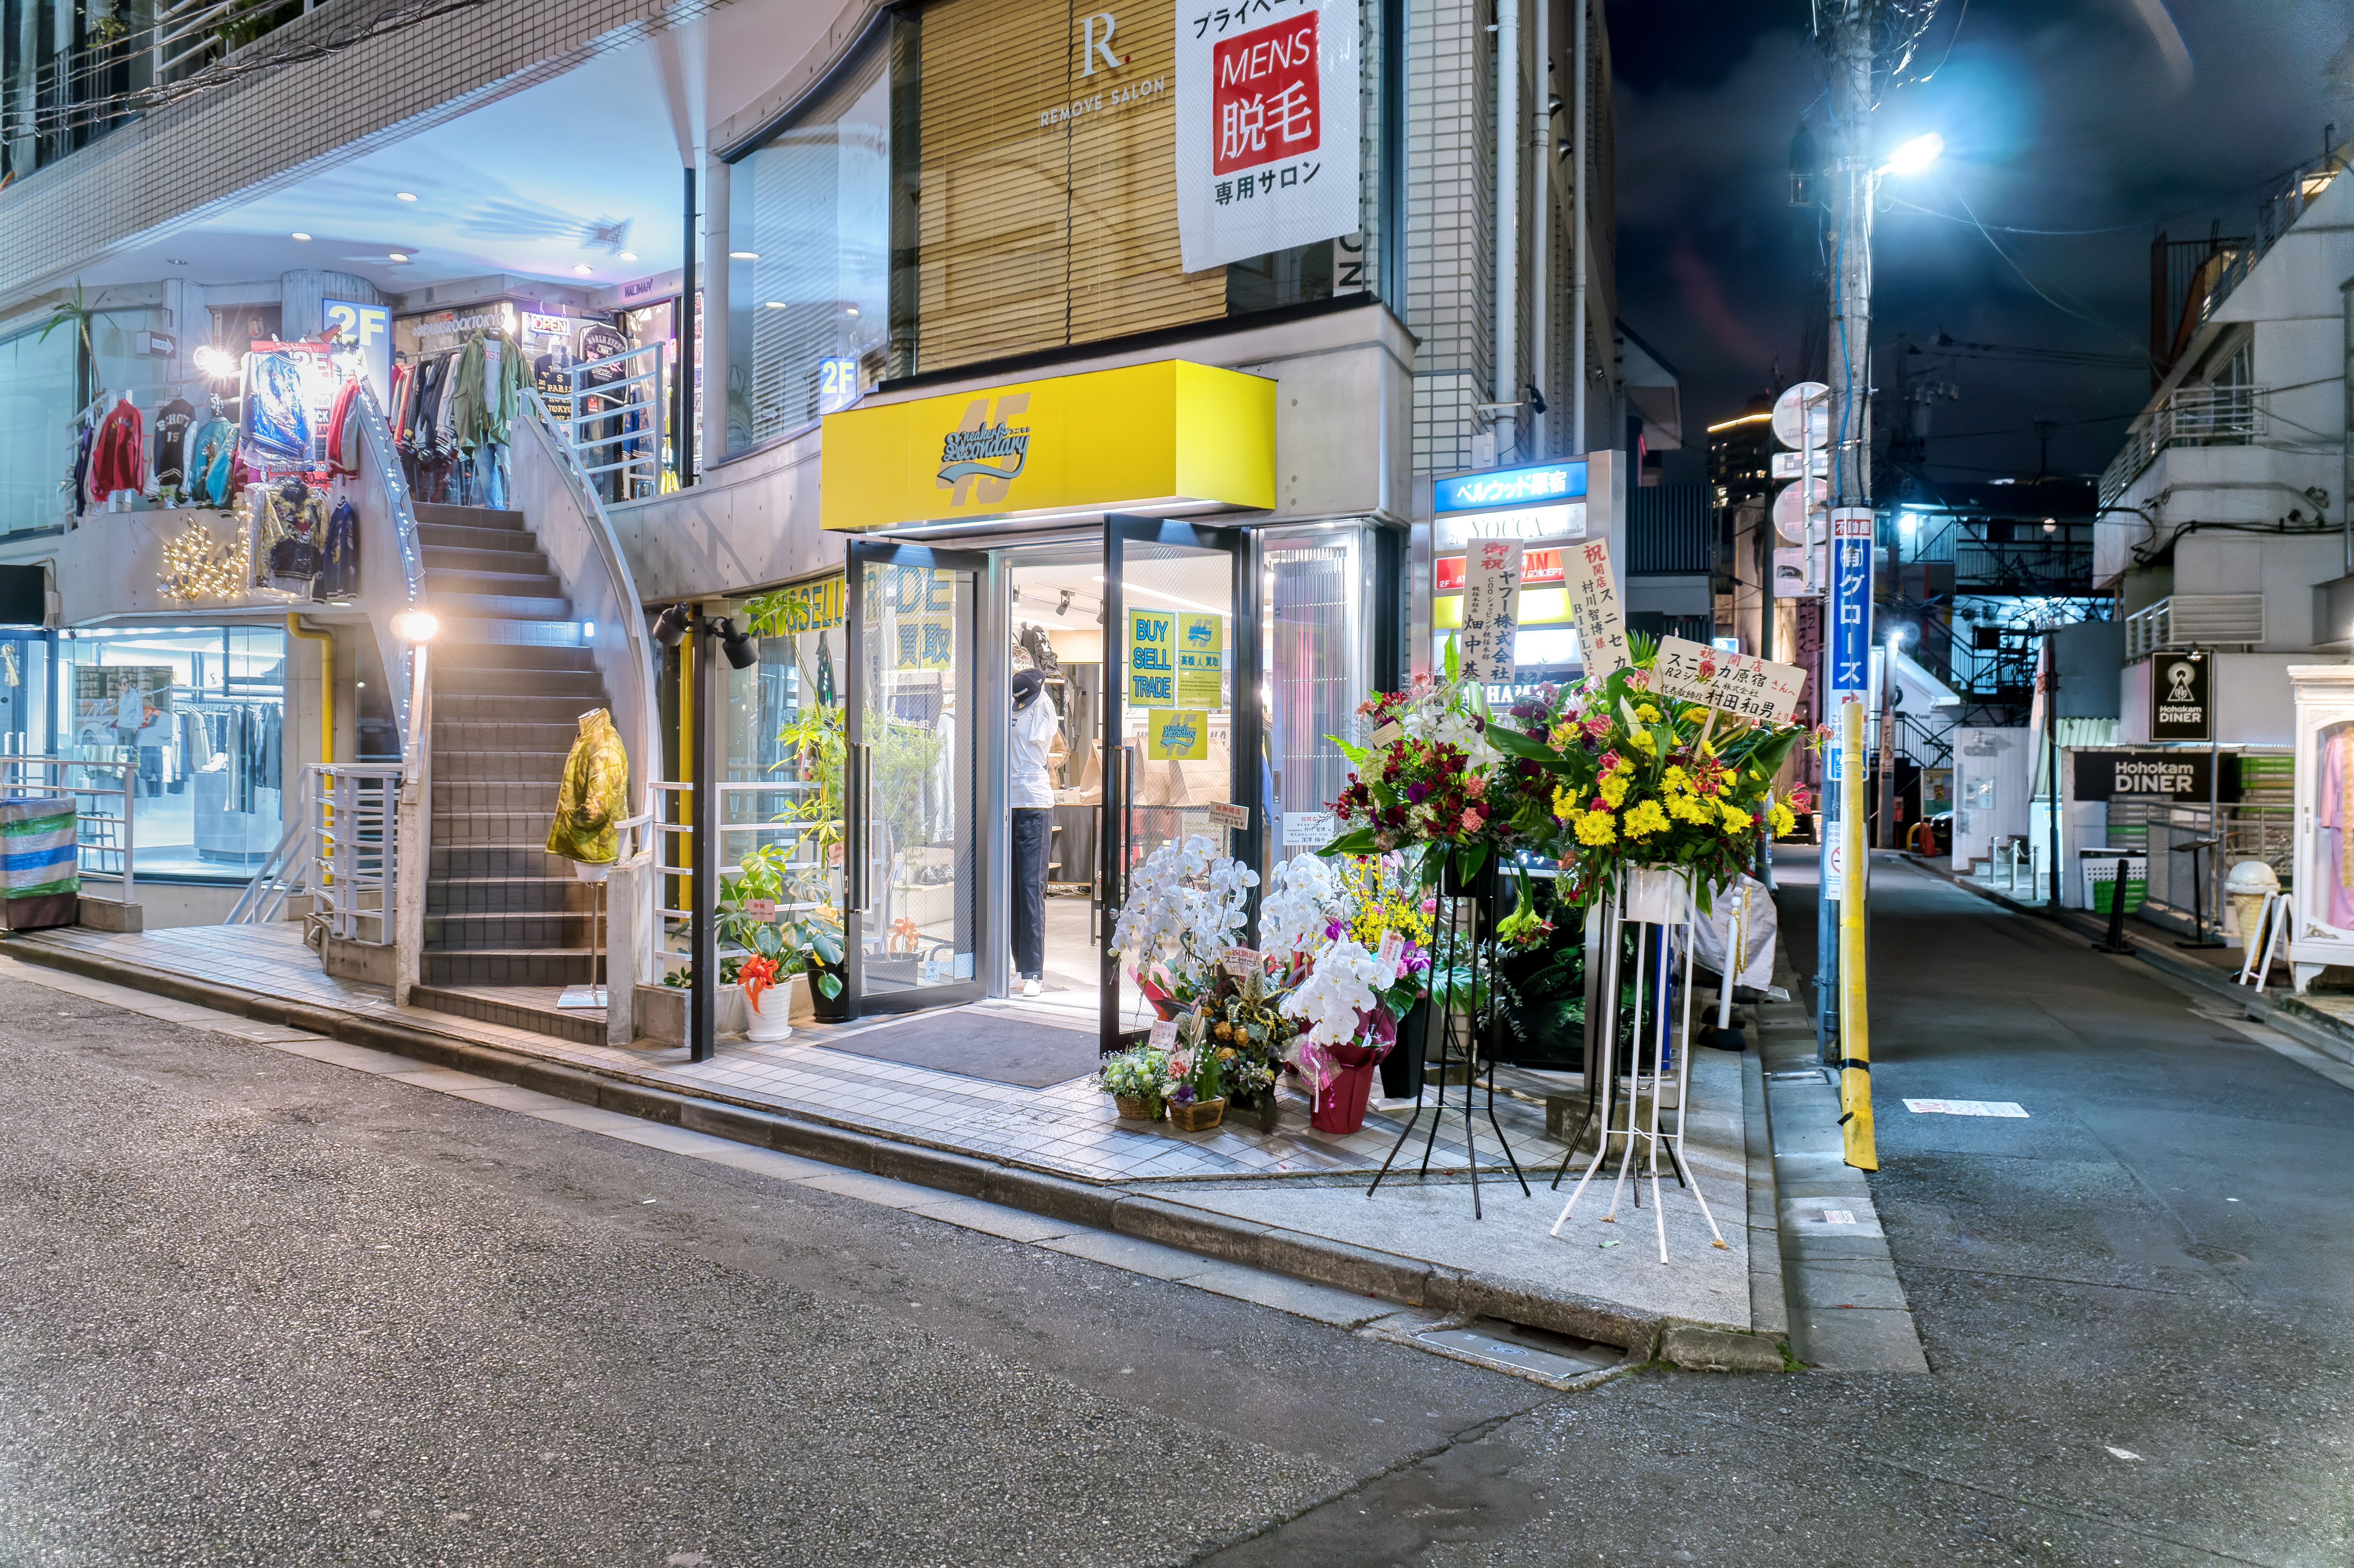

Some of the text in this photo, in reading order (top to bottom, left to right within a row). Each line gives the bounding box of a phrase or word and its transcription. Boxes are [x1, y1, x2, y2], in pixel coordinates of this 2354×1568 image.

[1194, 0, 1304, 39] プライー
[1221, 29, 1311, 89] MENS
[1040, 75, 1164, 127] REMOVE SALON
[1220, 80, 1312, 161] 脱毛
[1214, 161, 1320, 206] 専用サロン
[328, 305, 386, 346] 2F
[534, 317, 567, 333] OPEN
[822, 361, 854, 394] 2F
[936, 392, 1031, 507] 45
[1457, 470, 1566, 502] ベルウッド原宿
[1835, 521, 1870, 535] 不動産
[1480, 541, 1511, 570] 御祝
[1527, 567, 1563, 578] CONCEPT
[1136, 619, 1168, 642] BUY
[1490, 571, 1516, 681] ヤフー株式会社
[1600, 588, 1626, 670] スニセカ
[898, 623, 951, 666] 買取
[1133, 647, 1171, 670] SELL
[1700, 646, 1764, 672] 祝開店
[1181, 655, 1219, 666] 高額 買取
[1667, 653, 1768, 688] スニカ原宿
[1133, 675, 1171, 698] TRADE
[1705, 689, 1775, 719] 村田和男
[2159, 713, 2202, 723] DINER
[2115, 761, 2194, 775] Hohokam
[2115, 774, 2193, 792] DINER
